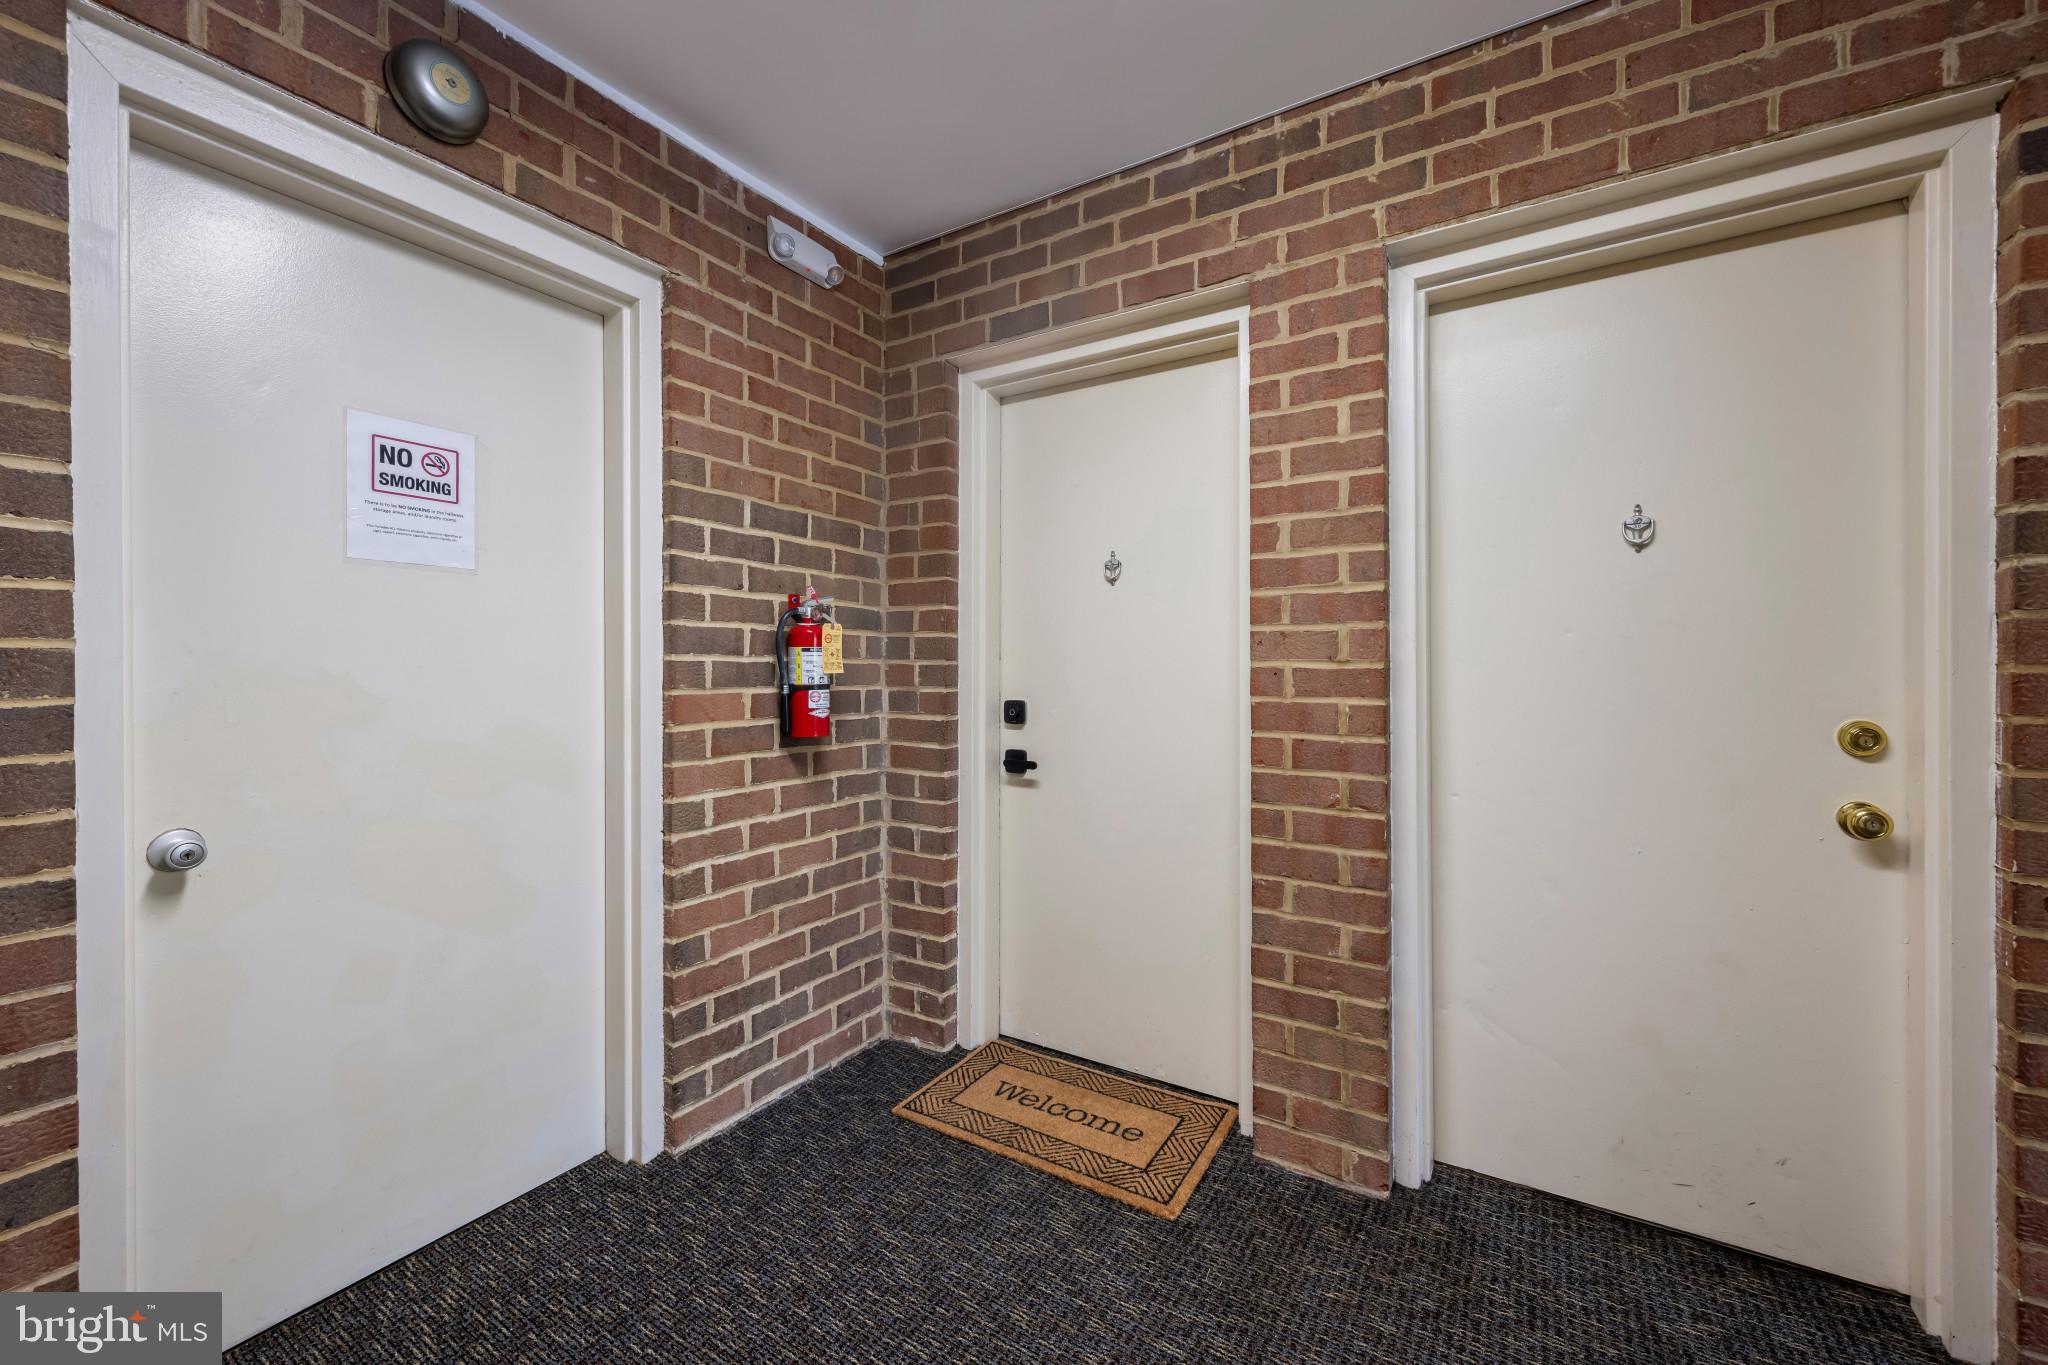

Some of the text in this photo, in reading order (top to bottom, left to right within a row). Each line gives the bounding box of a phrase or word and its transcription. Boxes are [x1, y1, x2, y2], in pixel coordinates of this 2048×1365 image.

[379, 443, 413, 468] NO
[378, 472, 452, 496] SMOKING
[407, 505, 431, 513] SMOKING
[994, 1080, 1144, 1142] Welcome
